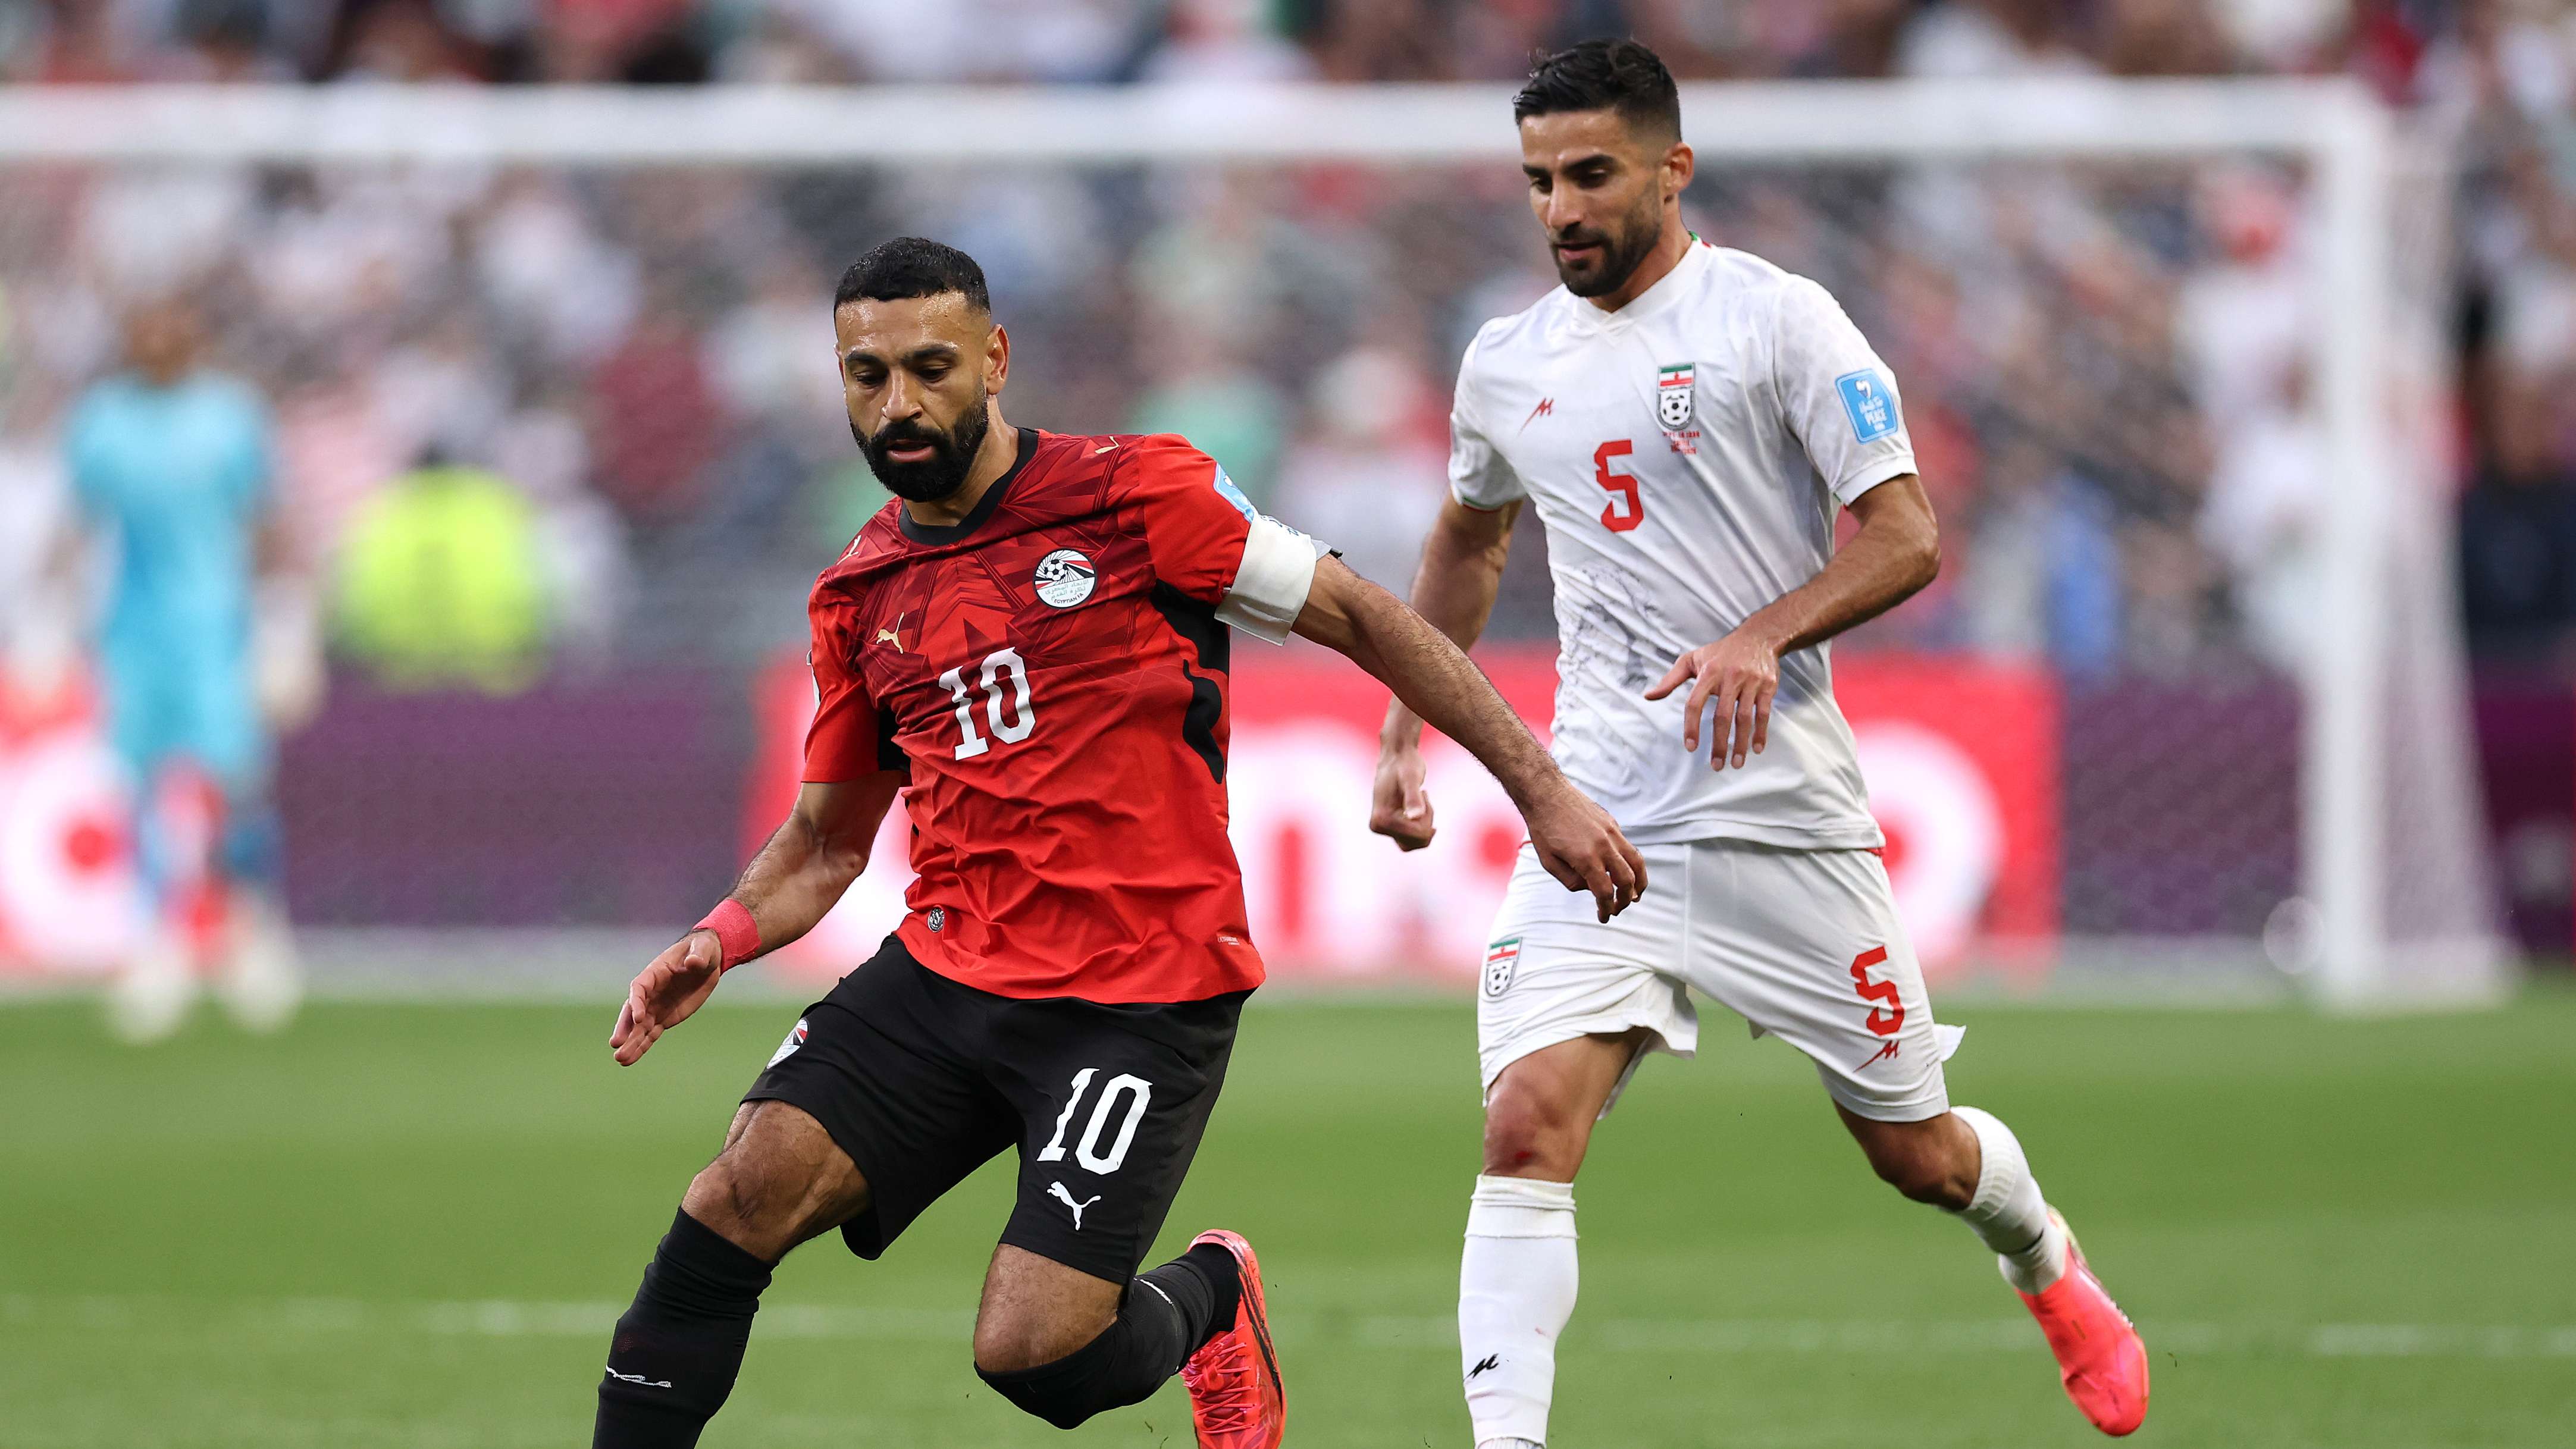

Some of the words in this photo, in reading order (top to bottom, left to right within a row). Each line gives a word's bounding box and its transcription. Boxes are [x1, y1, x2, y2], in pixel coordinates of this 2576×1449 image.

[1594, 439, 1644, 532] 5
[939, 647, 1036, 761] 10
[1850, 945, 1904, 1036] 5
[1036, 1068, 1153, 1175] 10
